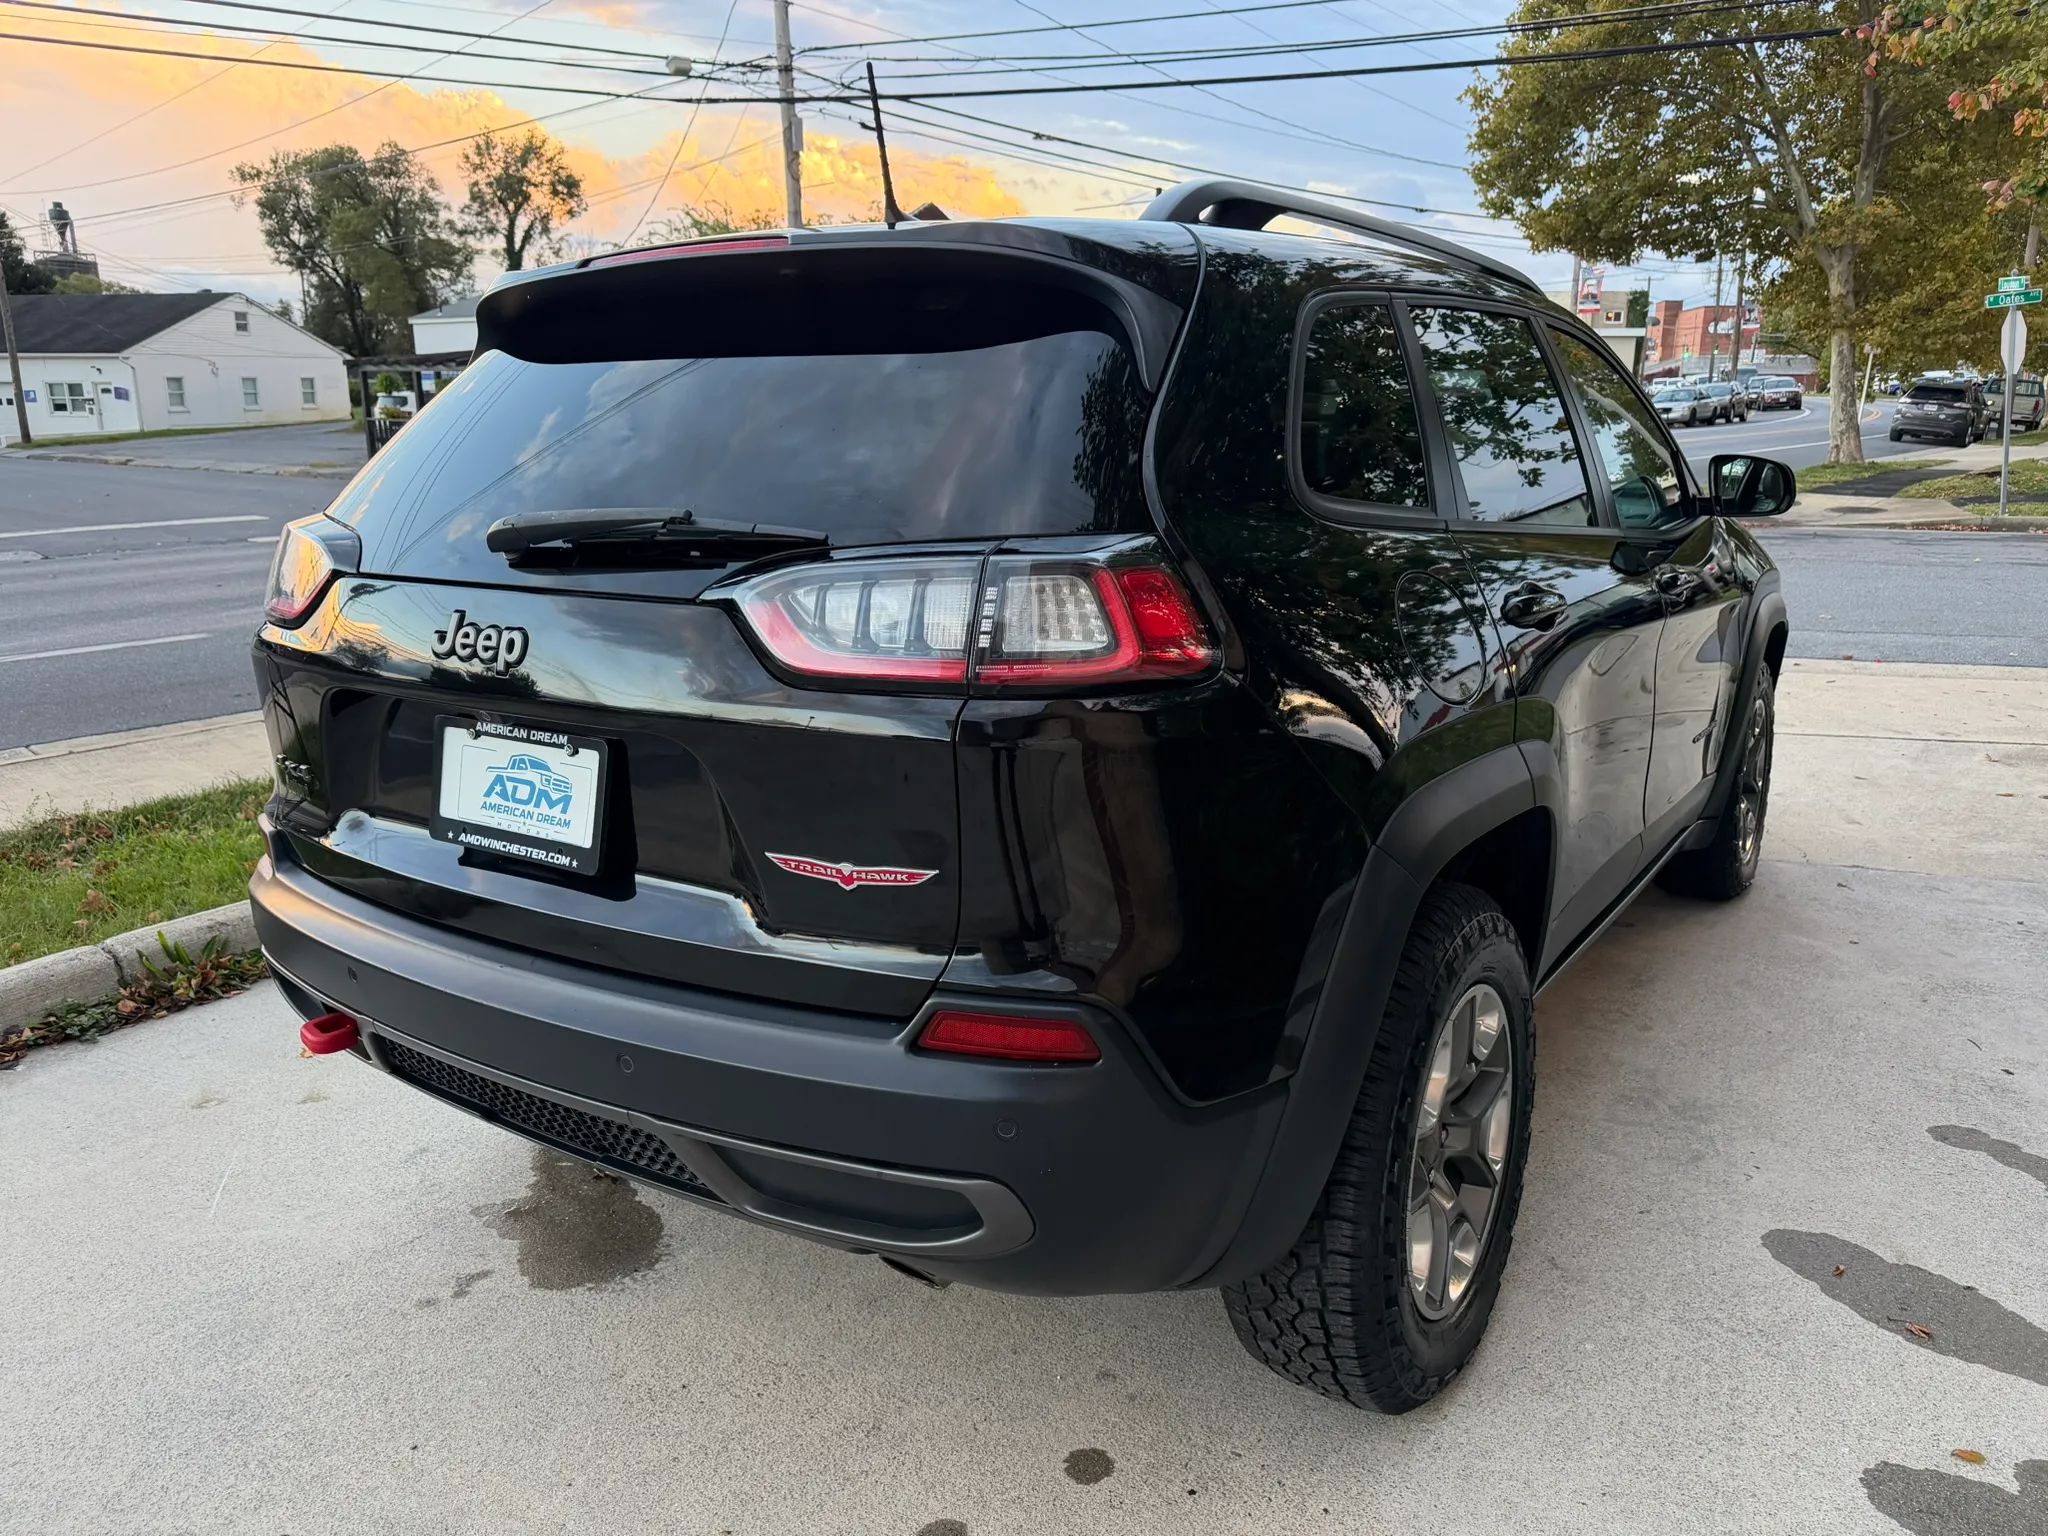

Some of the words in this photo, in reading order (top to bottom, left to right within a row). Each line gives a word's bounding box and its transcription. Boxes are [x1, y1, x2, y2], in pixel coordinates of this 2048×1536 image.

[1998, 294, 2025, 305] Oates
[432, 609, 529, 677] Jeep
[475, 721, 528, 739] AMERICAN
[529, 730, 569, 745] DREAM
[482, 774, 573, 815] ADM
[480, 801, 535, 821] AMERICAN
[536, 812, 572, 830] DREAM
[497, 821, 549, 839] MOTORS
[458, 832, 571, 867] AMDWINCHESTER.COM
